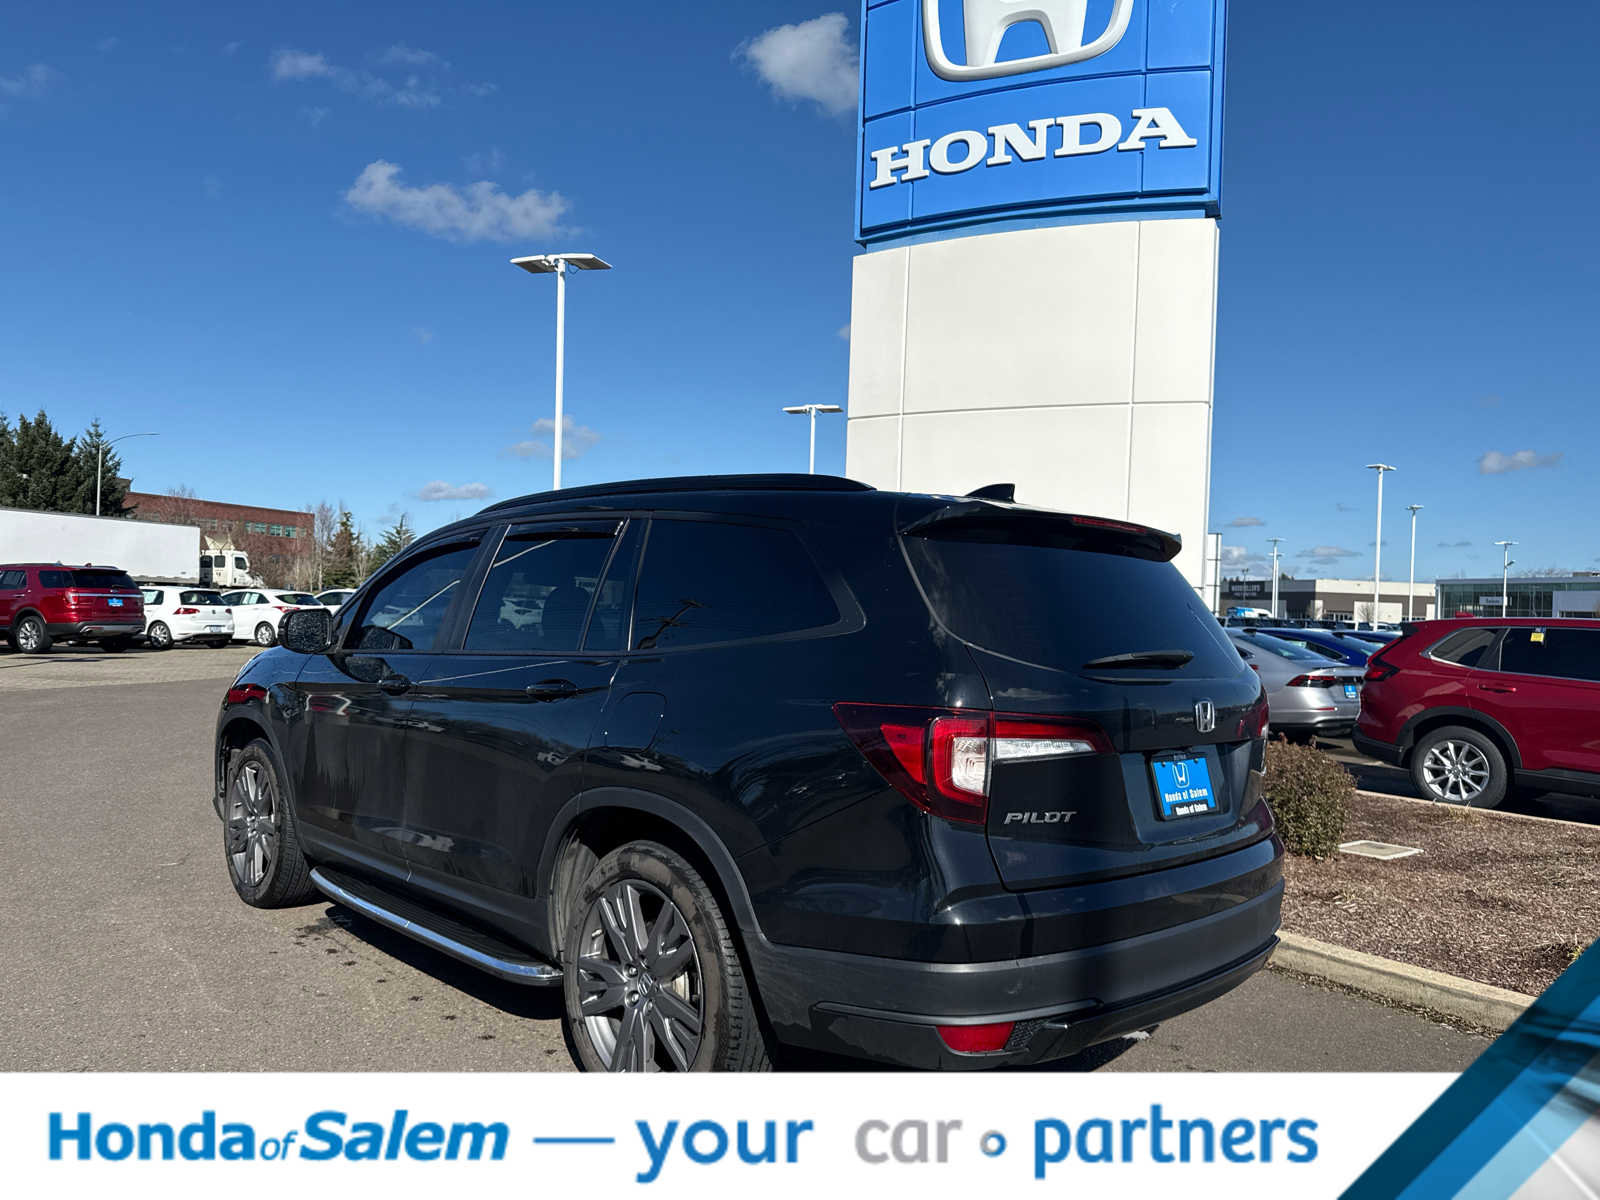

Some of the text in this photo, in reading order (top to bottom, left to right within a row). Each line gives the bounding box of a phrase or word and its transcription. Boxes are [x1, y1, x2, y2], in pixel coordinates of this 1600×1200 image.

[869, 107, 1198, 190] HONDA
[1165, 791, 1182, 803] Honda
[1189, 787, 1209, 799] Salem
[1004, 811, 1077, 825] PILOT
